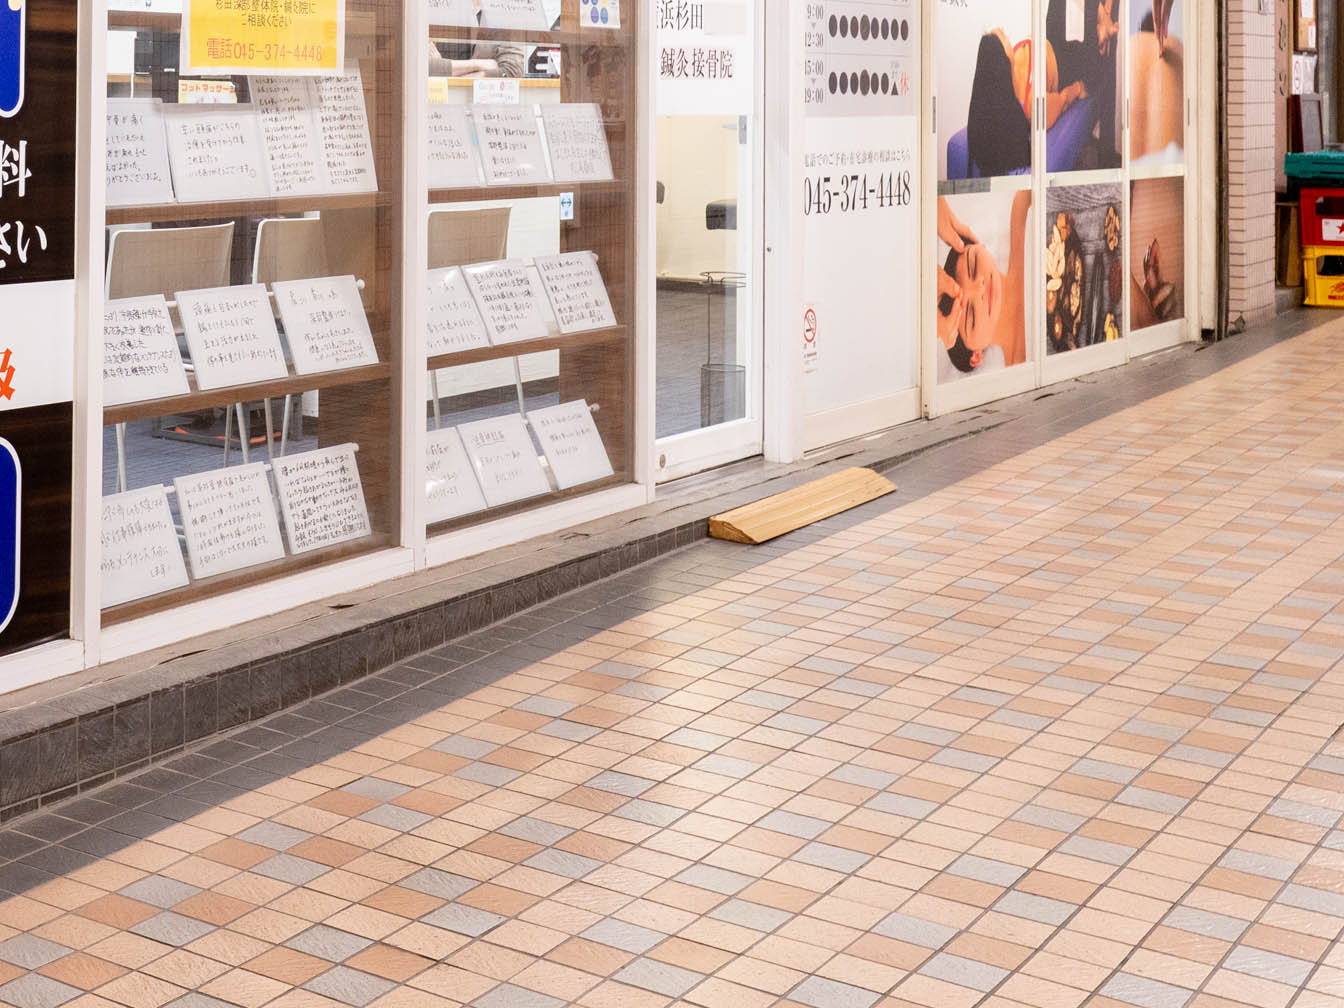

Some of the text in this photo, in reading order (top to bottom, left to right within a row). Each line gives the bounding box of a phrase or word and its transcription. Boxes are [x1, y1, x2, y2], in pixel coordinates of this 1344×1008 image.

[656, 0, 703, 31] 浜杉田
[804, 170, 911, 215] 045-374-4448
